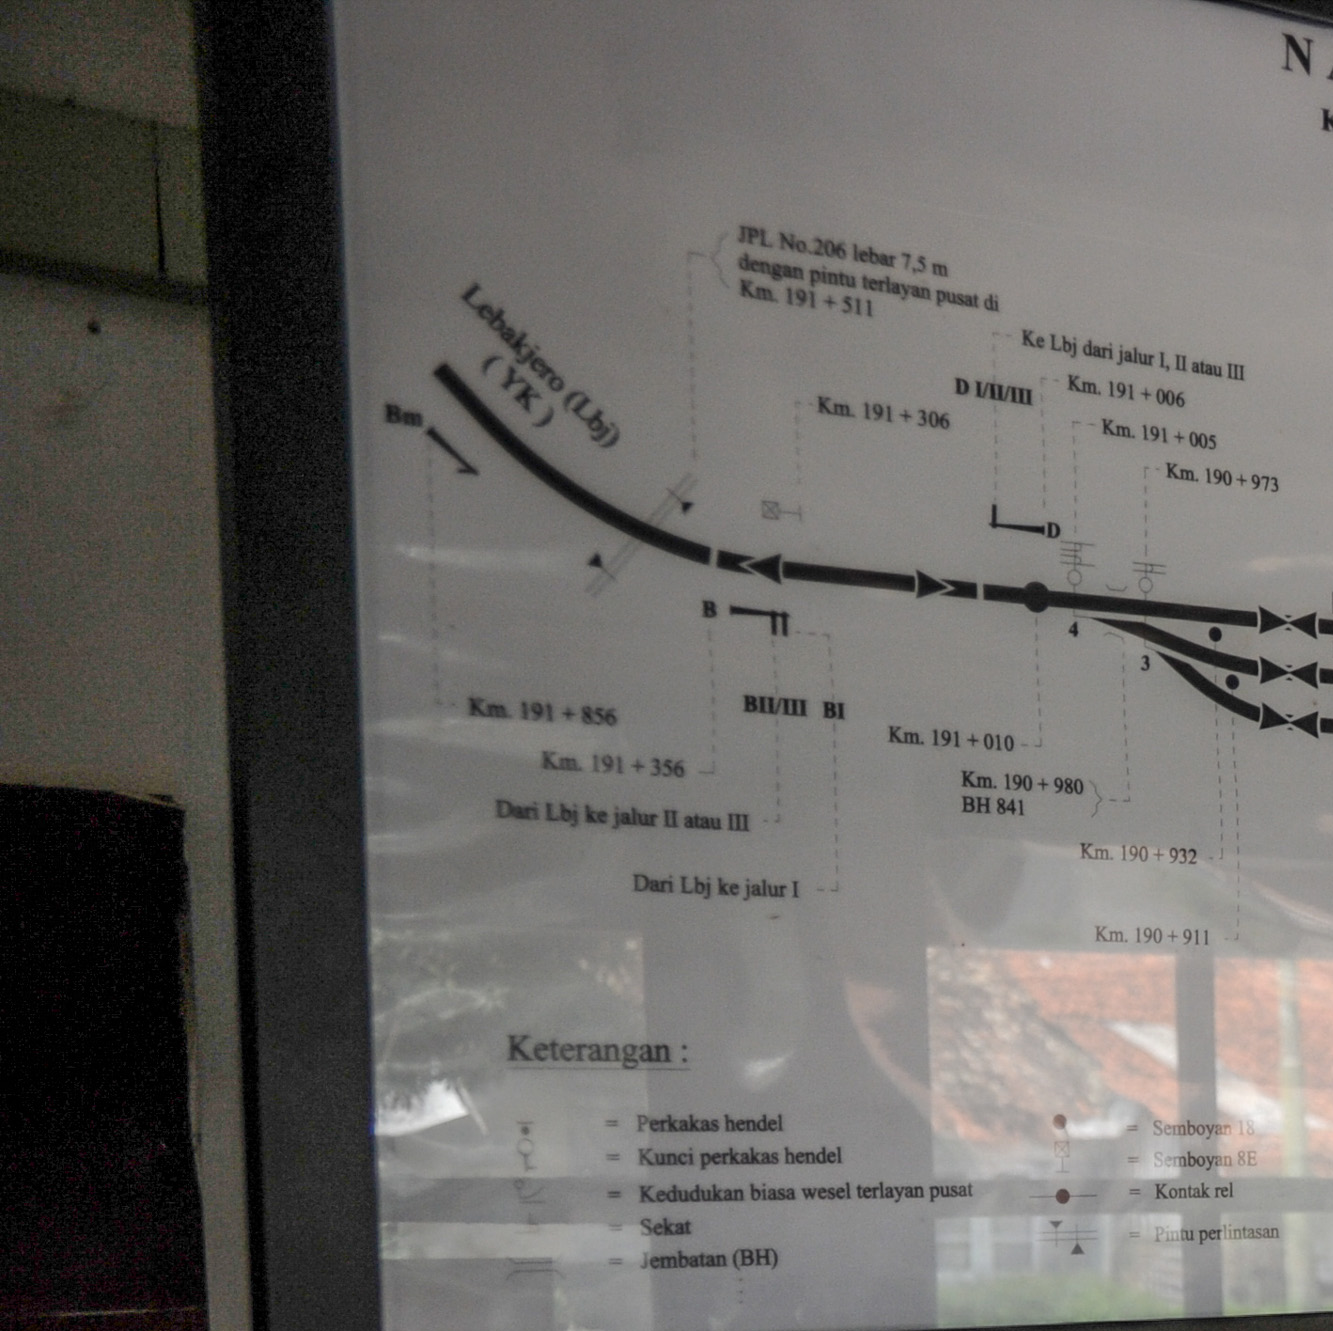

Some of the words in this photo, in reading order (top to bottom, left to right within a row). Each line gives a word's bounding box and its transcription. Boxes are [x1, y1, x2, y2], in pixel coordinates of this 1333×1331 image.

[738, 226, 772, 248] JPL
[779, 233, 846, 260] No.206
[853, 243, 895, 269] lebar
[900, 251, 927, 276] 7,5
[932, 262, 948, 277] m
[739, 254, 802, 284] dengan
[810, 265, 856, 291] pintu
[862, 273, 930, 303] terlayan
[936, 284, 979, 310] pusat
[984, 293, 999, 312] di
[461, 283, 563, 393] Lebakjero
[565, 390, 621, 448] (Lbj)
[1022, 330, 1044, 349] Ke
[1050, 334, 1078, 359] Lbj
[1083, 340, 1113, 360] dari
[1118, 345, 1153, 369] jalur
[1159, 351, 1171, 370] I,
[1175, 354, 1187, 370] II
[1192, 359, 1223, 377] atau
[1227, 362, 1245, 381] III
[962, 797, 990, 814] BH
[996, 799, 1024, 816] 841
[508, 1034, 671, 1069] Keterangan
[637, 1114, 720, 1133] Perkakas
[724, 1114, 783, 1133] hendel
[638, 1148, 694, 1166] Kunci
[700, 1148, 780, 1169] perkakas
[784, 1146, 842, 1165] hendel
[639, 1183, 745, 1203] Kedudukan
[750, 1182, 796, 1201] biasa
[801, 1182, 851, 1201] wesel
[856, 1181, 925, 1203] terlayan
[930, 1182, 973, 1199] pusat
[1155, 1182, 1210, 1199] Kontak
[1214, 1182, 1234, 1198] rel
[640, 1217, 691, 1236] Sekat
[640, 1250, 727, 1271] Jembatan
[733, 1248, 779, 1270] (BH)
